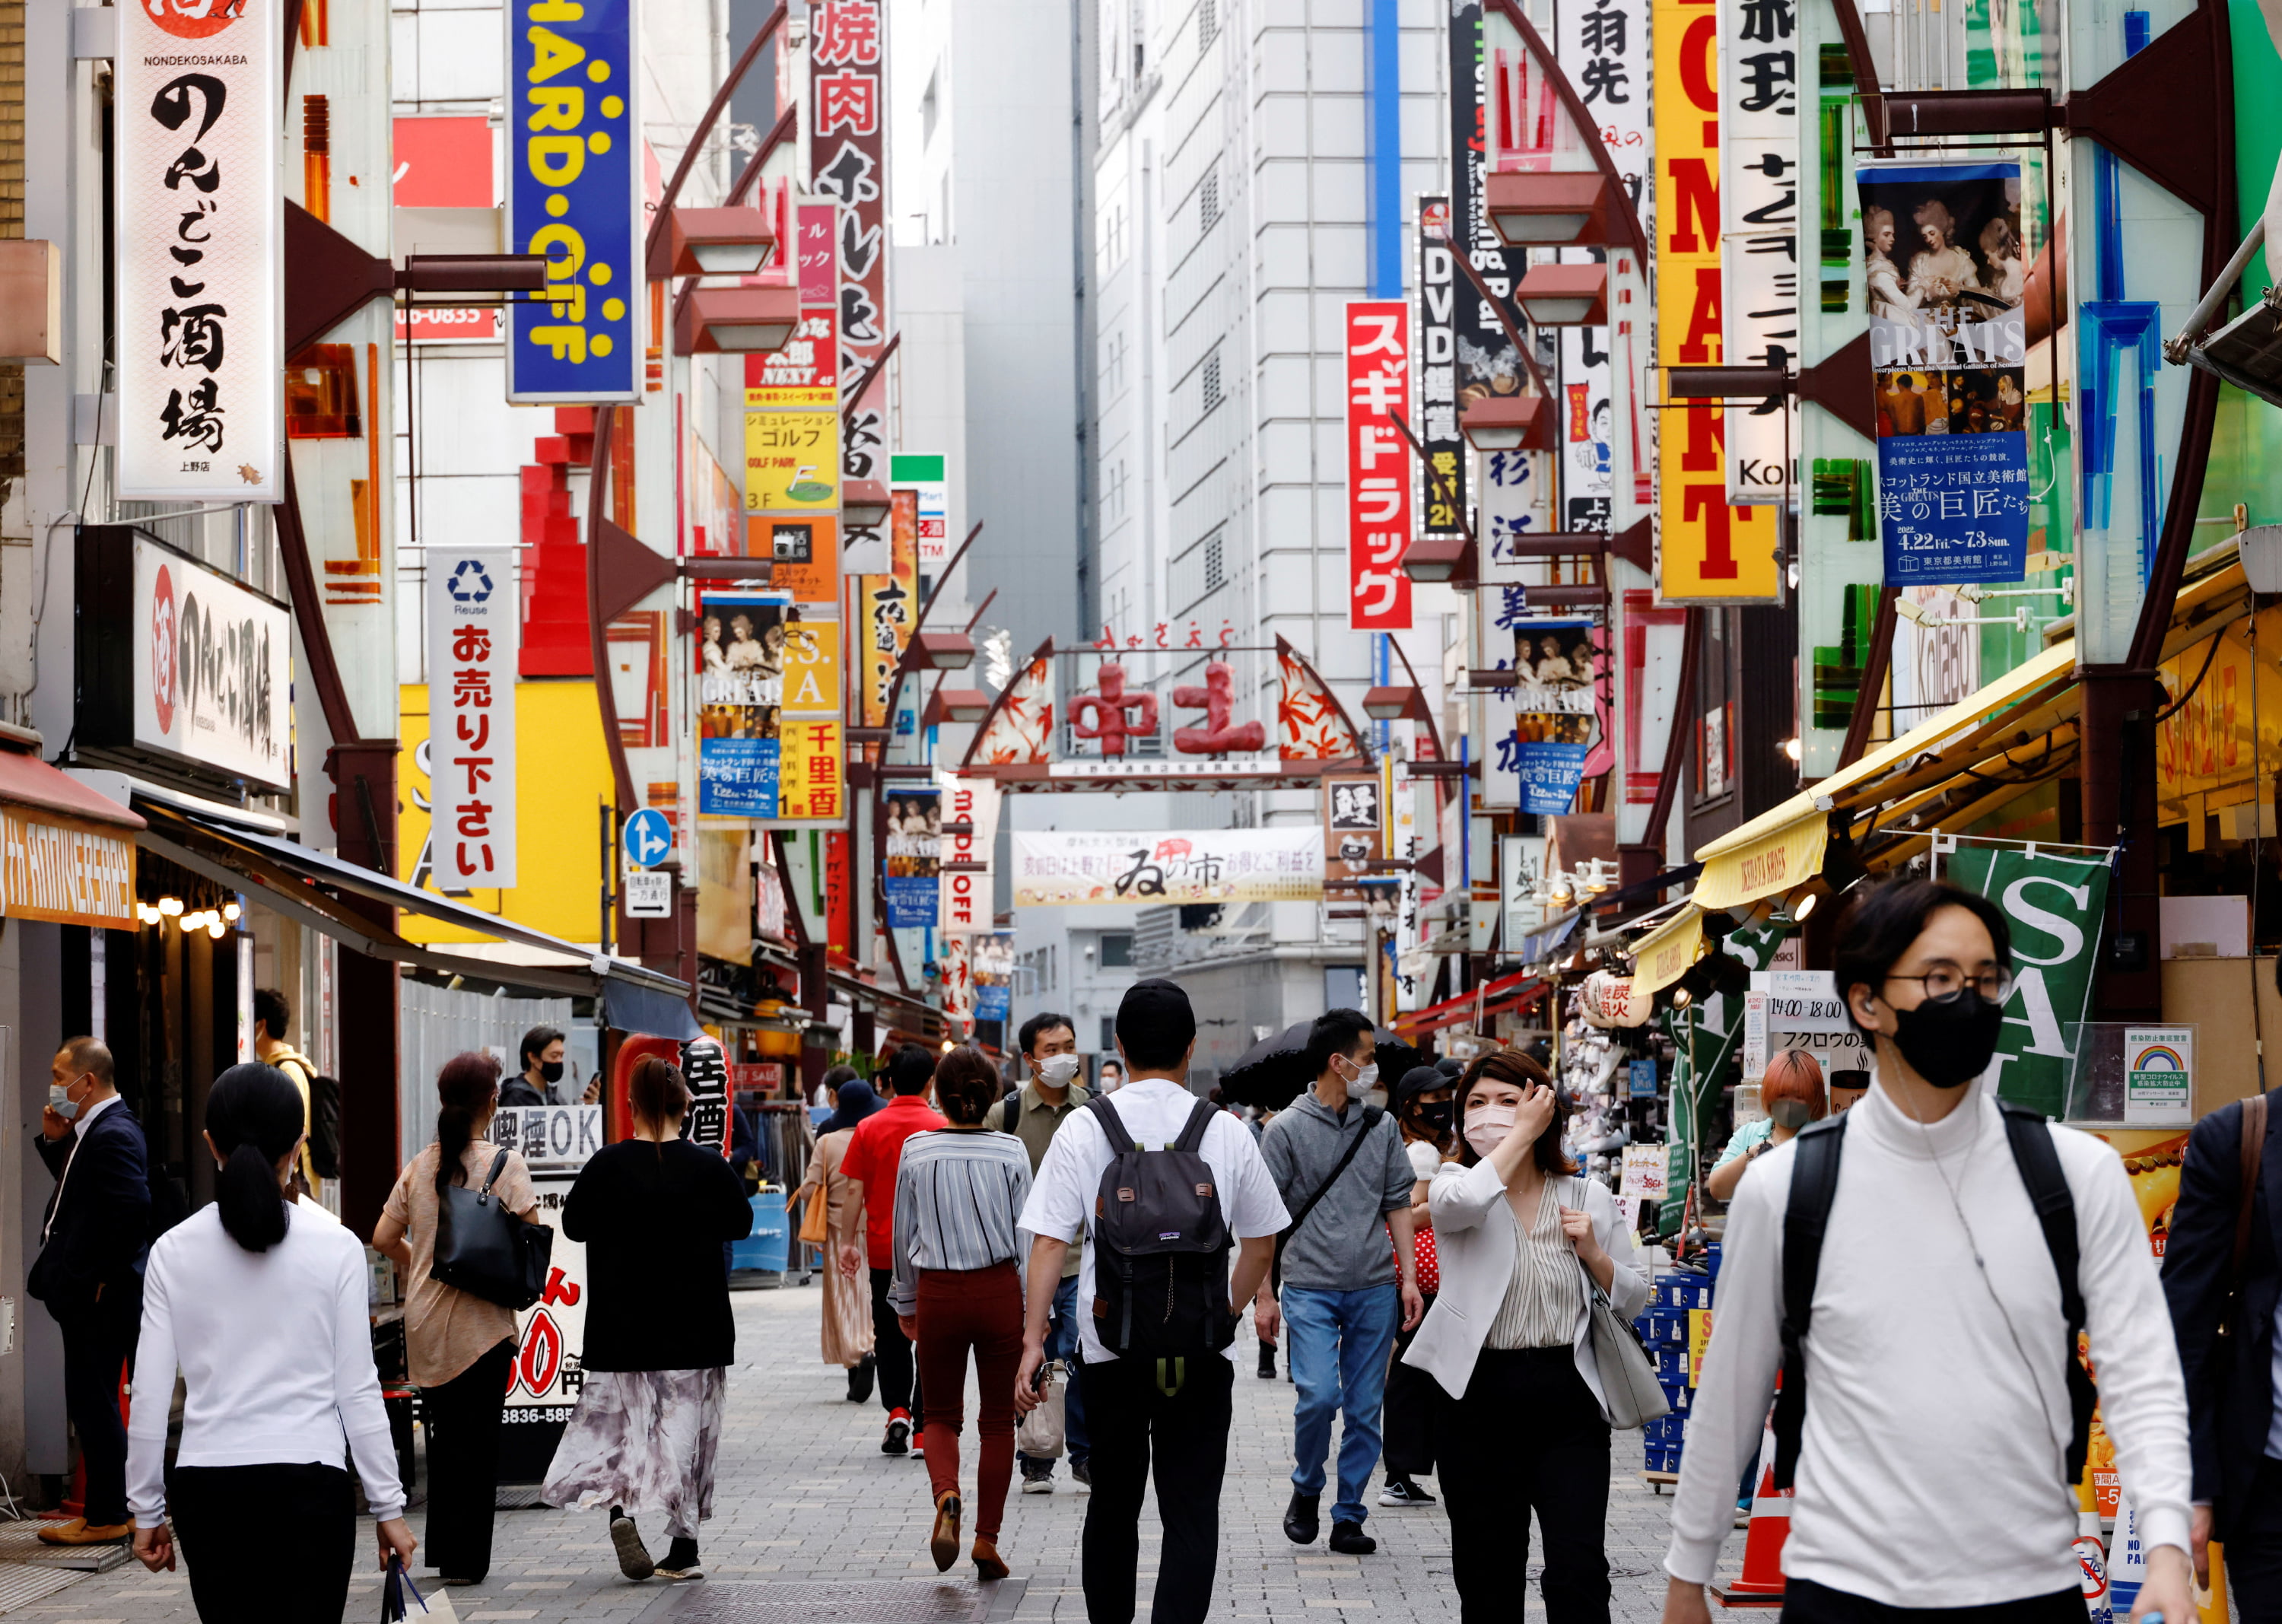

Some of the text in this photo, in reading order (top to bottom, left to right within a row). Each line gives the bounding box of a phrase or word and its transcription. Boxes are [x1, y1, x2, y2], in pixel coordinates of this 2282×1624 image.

[145, 55, 247, 66] NONDEKOSAKABA
[1581, 0, 1629, 105] 羽先
[151, 73, 227, 454] のんでこ酒場
[1914, 306, 1974, 330] THE
[1871, 321, 2025, 367] GREATS
[760, 367, 818, 386] NEXT
[1874, 366, 1908, 374] asterpieces
[748, 415, 835, 426] シミュレーション
[762, 428, 820, 447] ゴルフ
[180, 460, 210, 472] 上野店
[1350, 314, 1407, 617] スギドラッグ
[1880, 468, 2027, 488] スコットランド国立美術館
[748, 492, 772, 509] 3F
[1880, 488, 2030, 523] 美の巨匠たち
[1900, 491, 1940, 502] GREATS
[1923, 555, 1982, 566] 東京都美術館
[454, 605, 488, 615] Reuse
[453, 624, 494, 876] お売り下さい
[808, 724, 837, 816] 千里香
[1766, 846, 1786, 885] SHOES
[953, 876, 971, 923] OFF
[678, 1041, 728, 1153] 居酒
[485, 1109, 598, 1158] 喫煙OK
